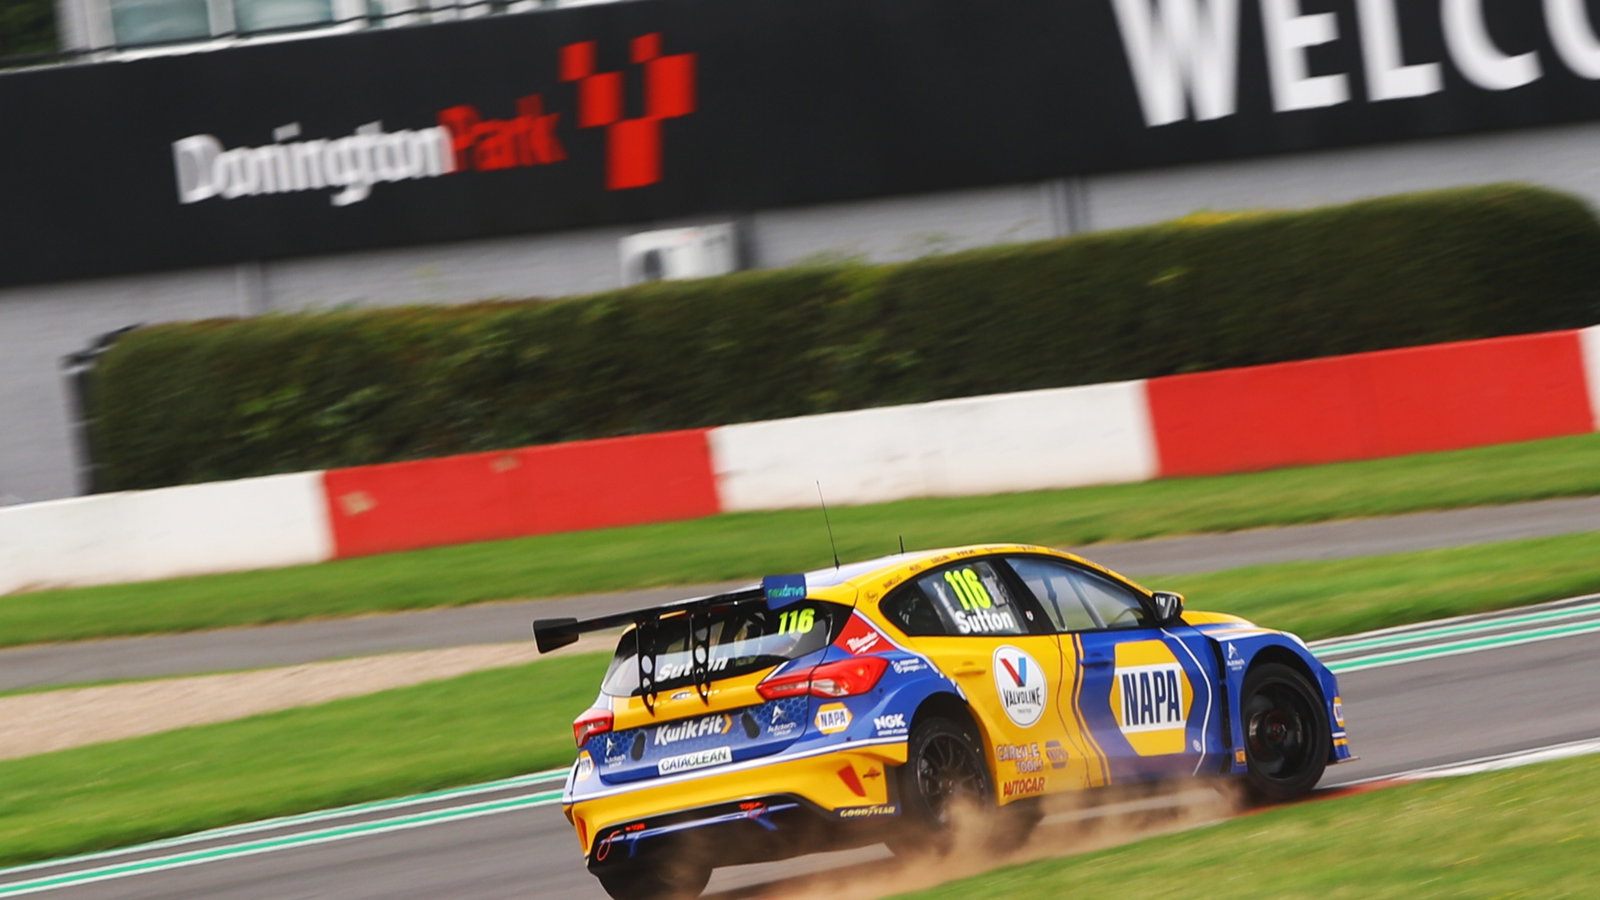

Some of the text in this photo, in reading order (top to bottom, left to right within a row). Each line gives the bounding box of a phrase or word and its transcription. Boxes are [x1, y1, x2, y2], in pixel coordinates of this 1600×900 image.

[1112, 0, 1600, 127] WELC
[944, 568, 991, 610] 116
[778, 608, 815, 636] 116
[955, 604, 1014, 634] Sutton
[1003, 687, 1041, 708] VALVOLINE
[1121, 667, 1181, 727] NAPA
[820, 709, 847, 728] NAPA
[873, 713, 906, 730] NGK
[660, 750, 728, 773] CATACLEAN
[1003, 777, 1045, 797] AUTOCAR
